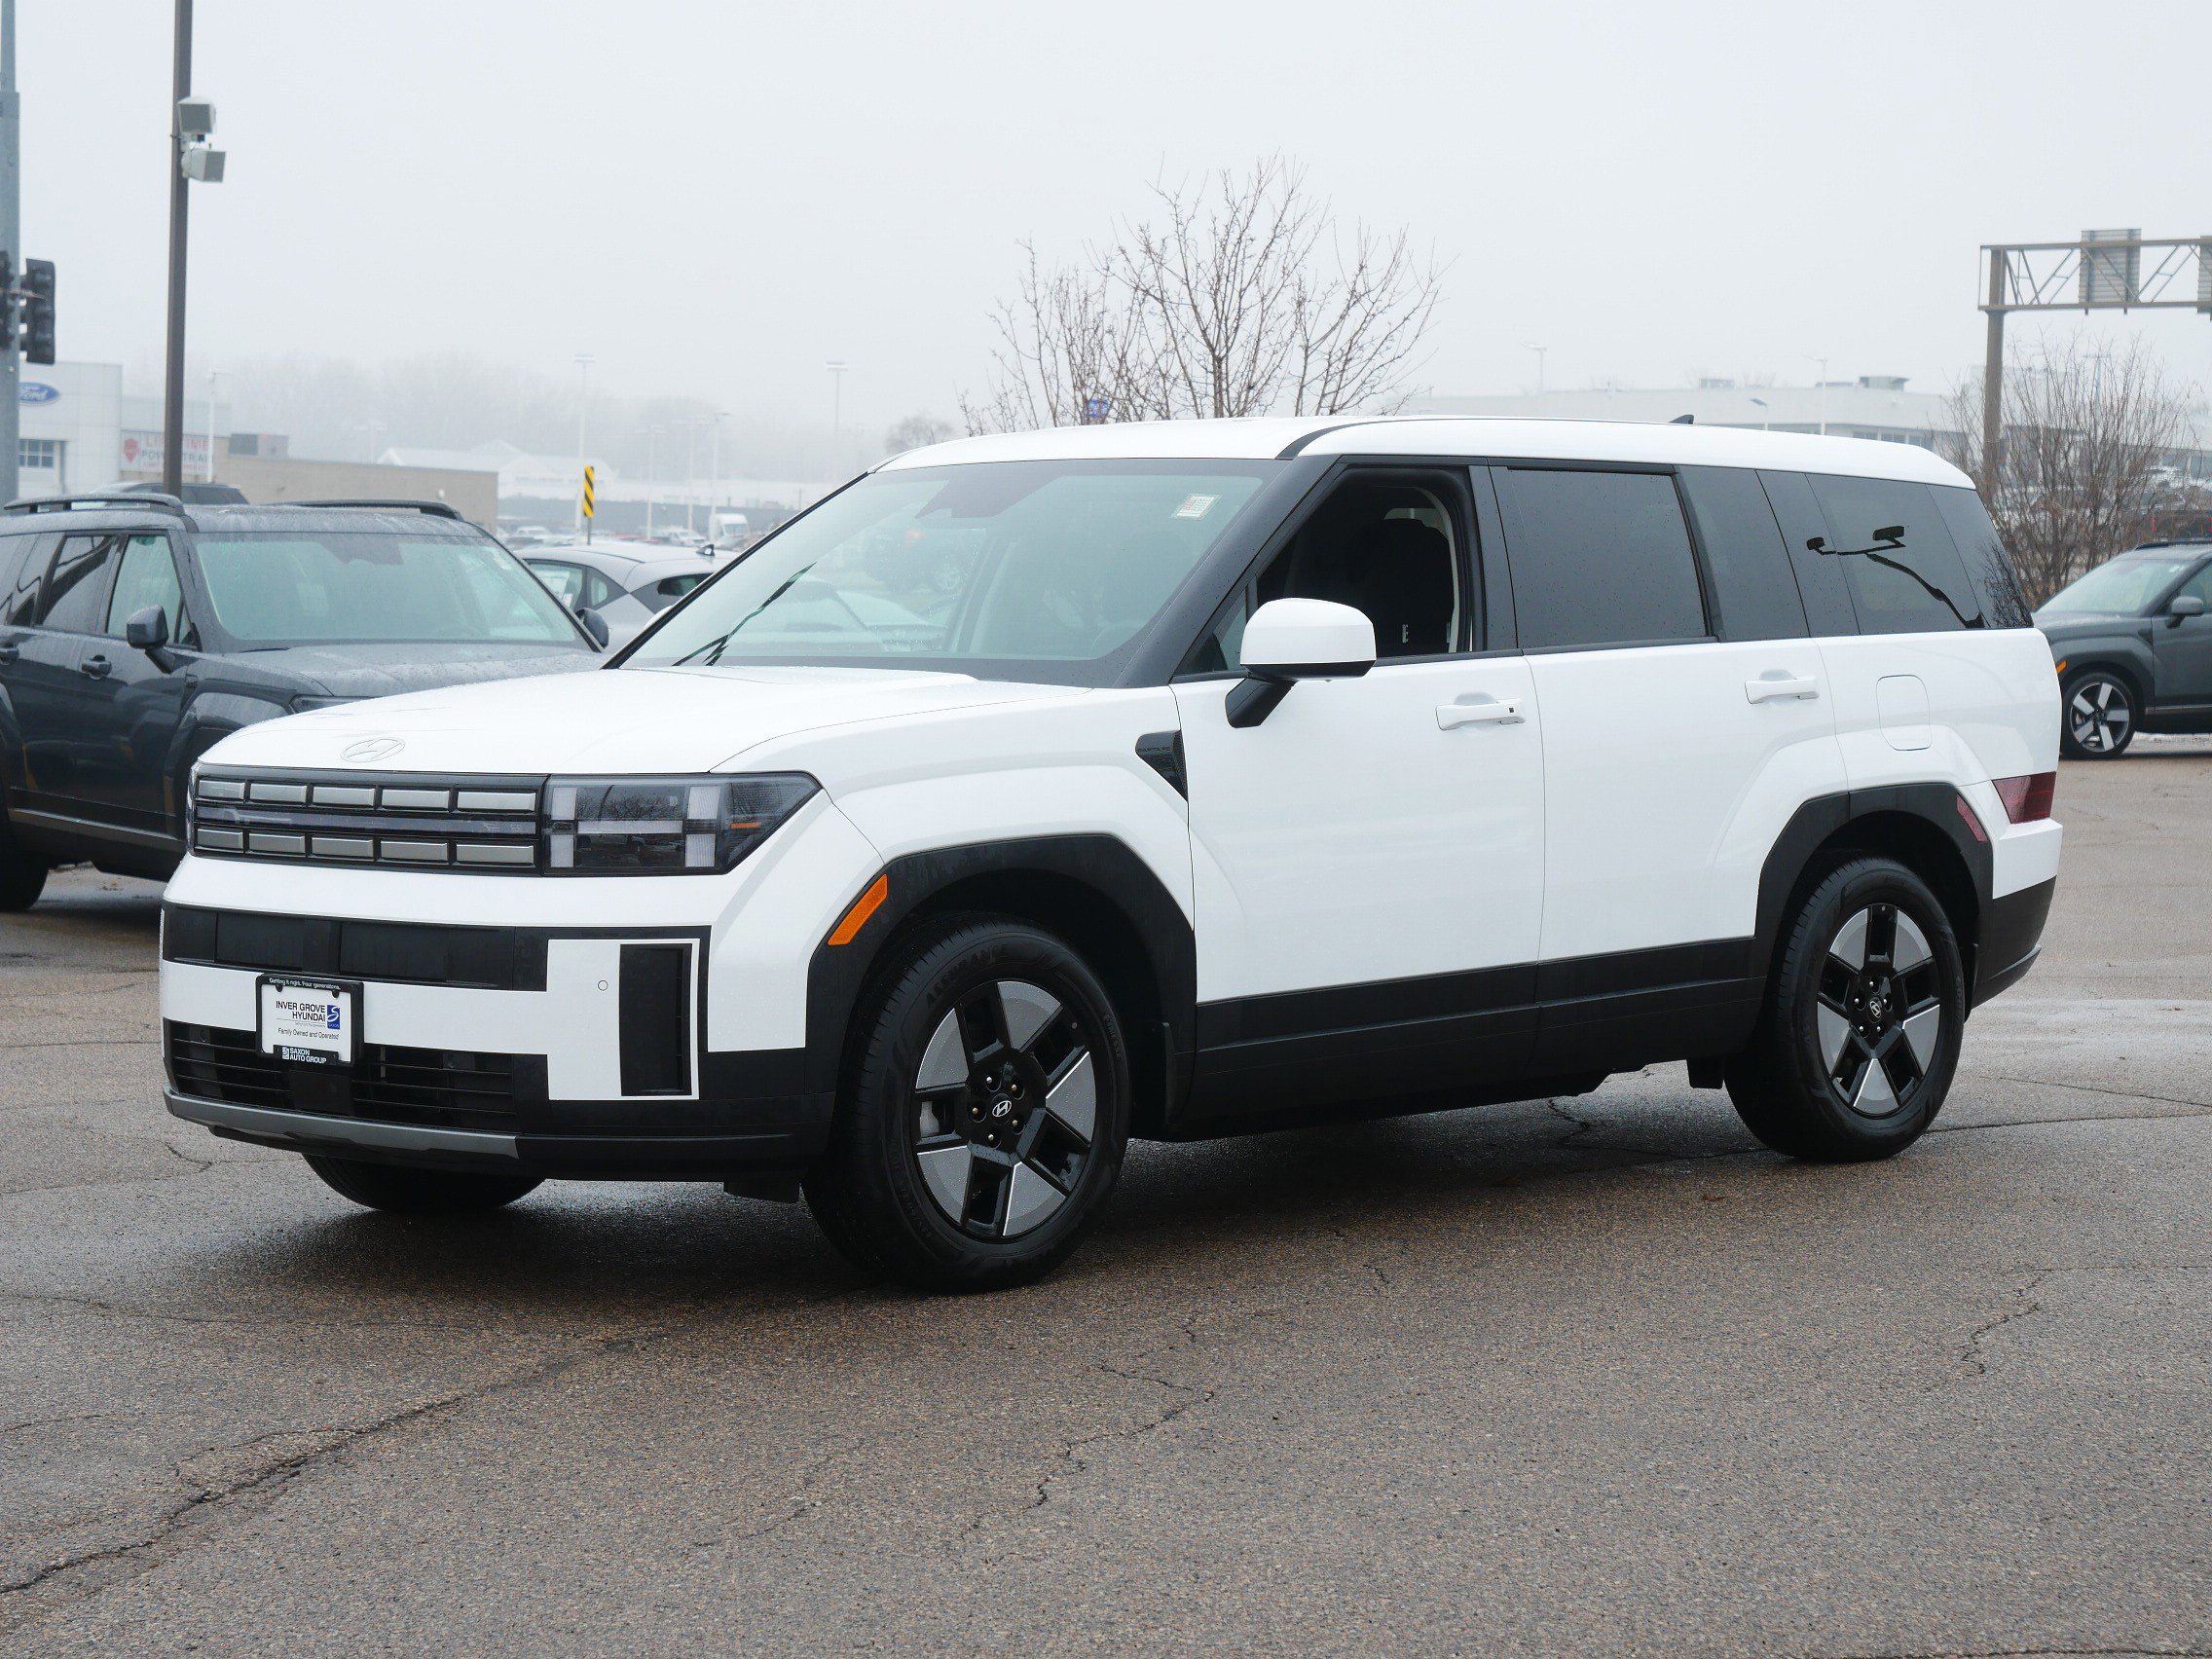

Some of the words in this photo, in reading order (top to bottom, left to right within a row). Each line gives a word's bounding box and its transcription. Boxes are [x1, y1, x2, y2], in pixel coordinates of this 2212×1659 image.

[276, 1001, 298, 1011] INVER
[299, 1003, 325, 1014] GROVE
[292, 1012, 326, 1022] HYUNDAI
[277, 1027, 292, 1036] Family
[289, 1047, 311, 1055] SAXON
[306, 1055, 327, 1064] GROUP
